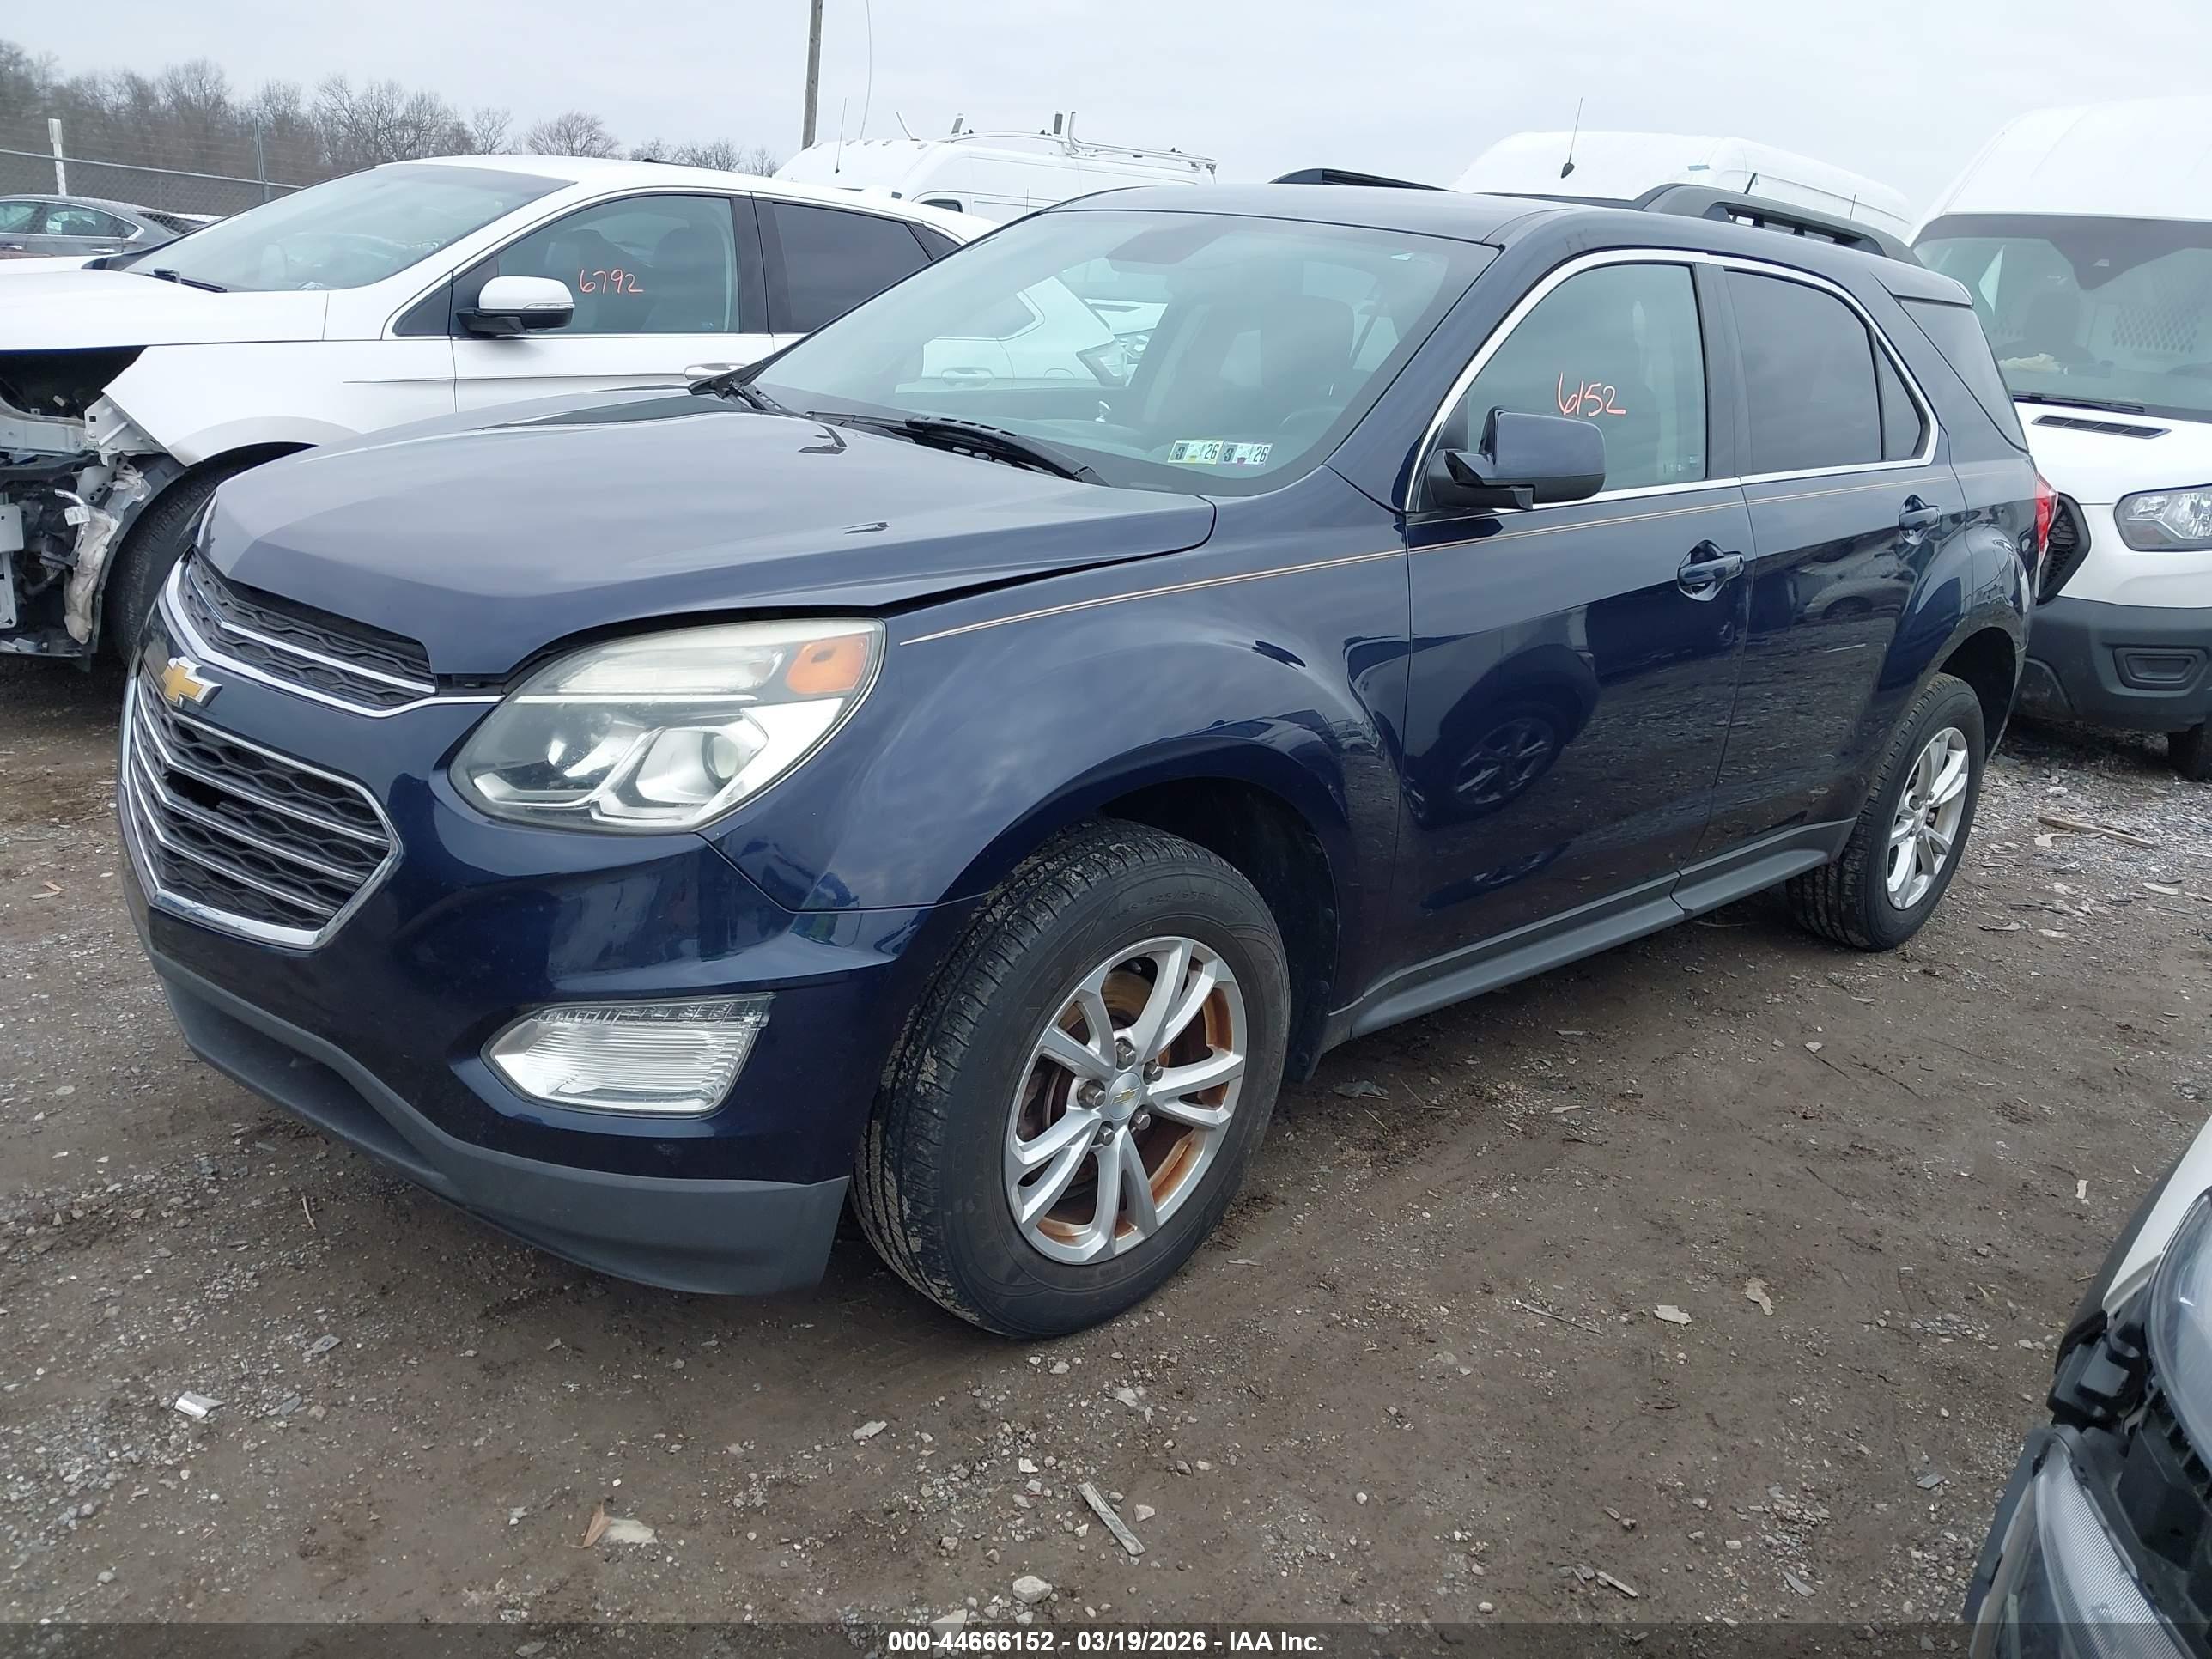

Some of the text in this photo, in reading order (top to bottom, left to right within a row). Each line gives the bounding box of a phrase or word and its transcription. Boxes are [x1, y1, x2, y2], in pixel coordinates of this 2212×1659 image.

[580, 269, 644, 294] 6792
[1556, 371, 1626, 416] 6152
[1175, 444, 1219, 460] 3 26
[1224, 446, 1269, 463] 3 26
